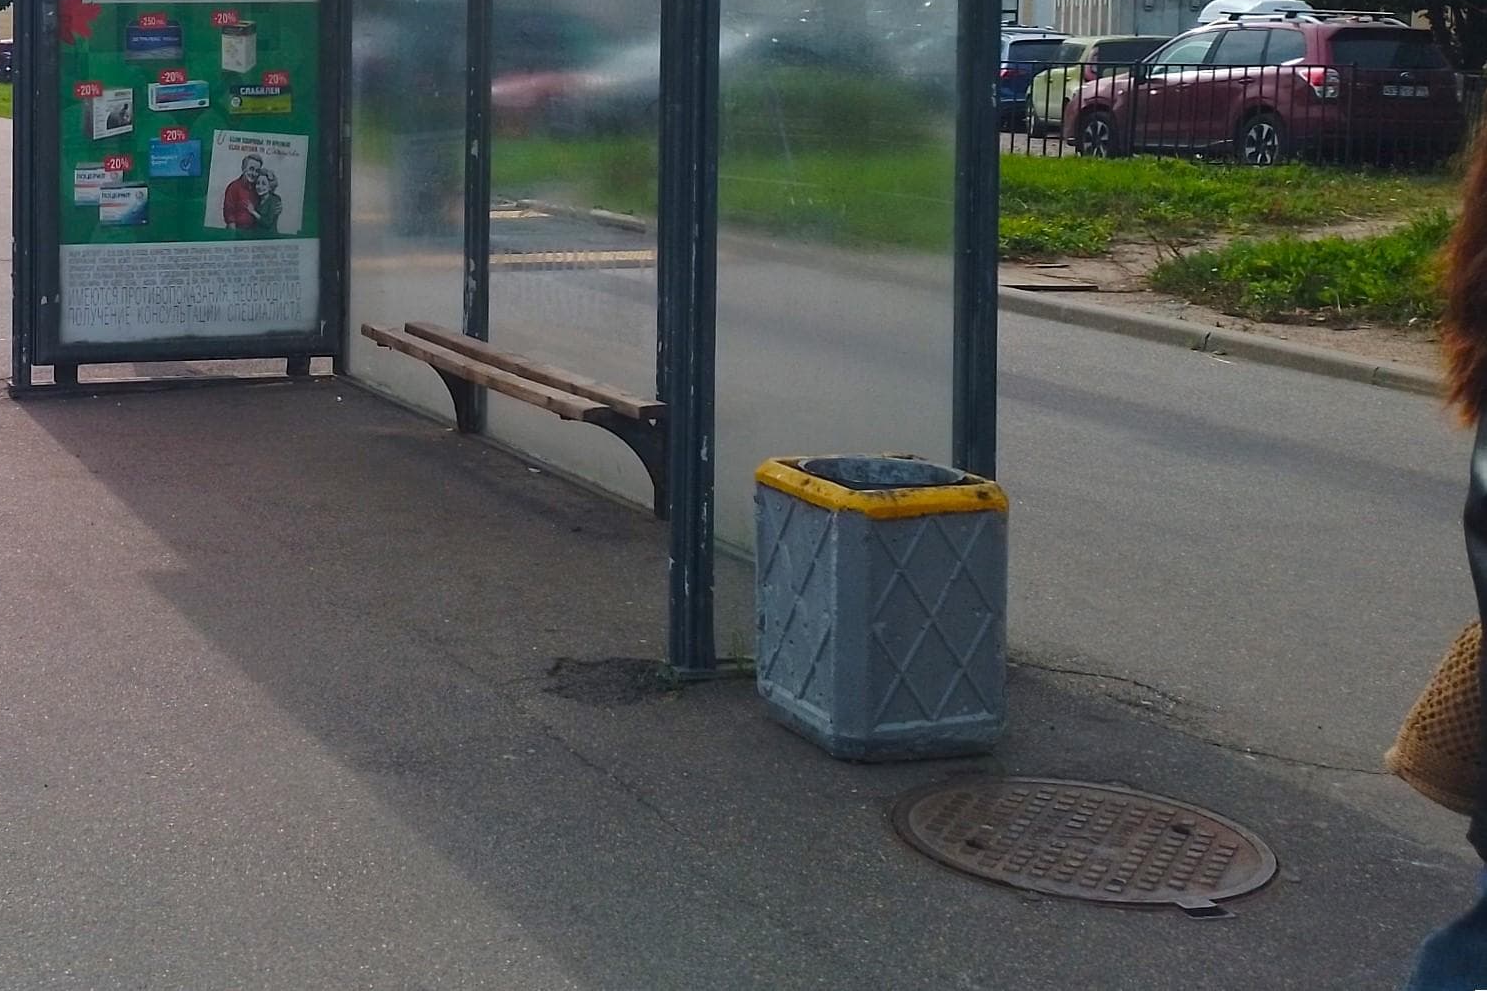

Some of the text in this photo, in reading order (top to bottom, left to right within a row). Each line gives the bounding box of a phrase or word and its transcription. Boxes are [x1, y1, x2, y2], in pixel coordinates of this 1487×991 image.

[161, 71, 184, 82] -20%
[77, 84, 100, 96] -20%
[163, 130, 186, 141] -20%
[107, 157, 129, 169] -20%
[68, 287, 119, 306] ИМЕЮТСЯ
[232, 281, 301, 303] НЕОБХОДИМО
[69, 301, 302, 327] ПОЛУЧЕНИЕ КОНСУЛЬТАЦИИ СПЕЦИАЛИСТА
